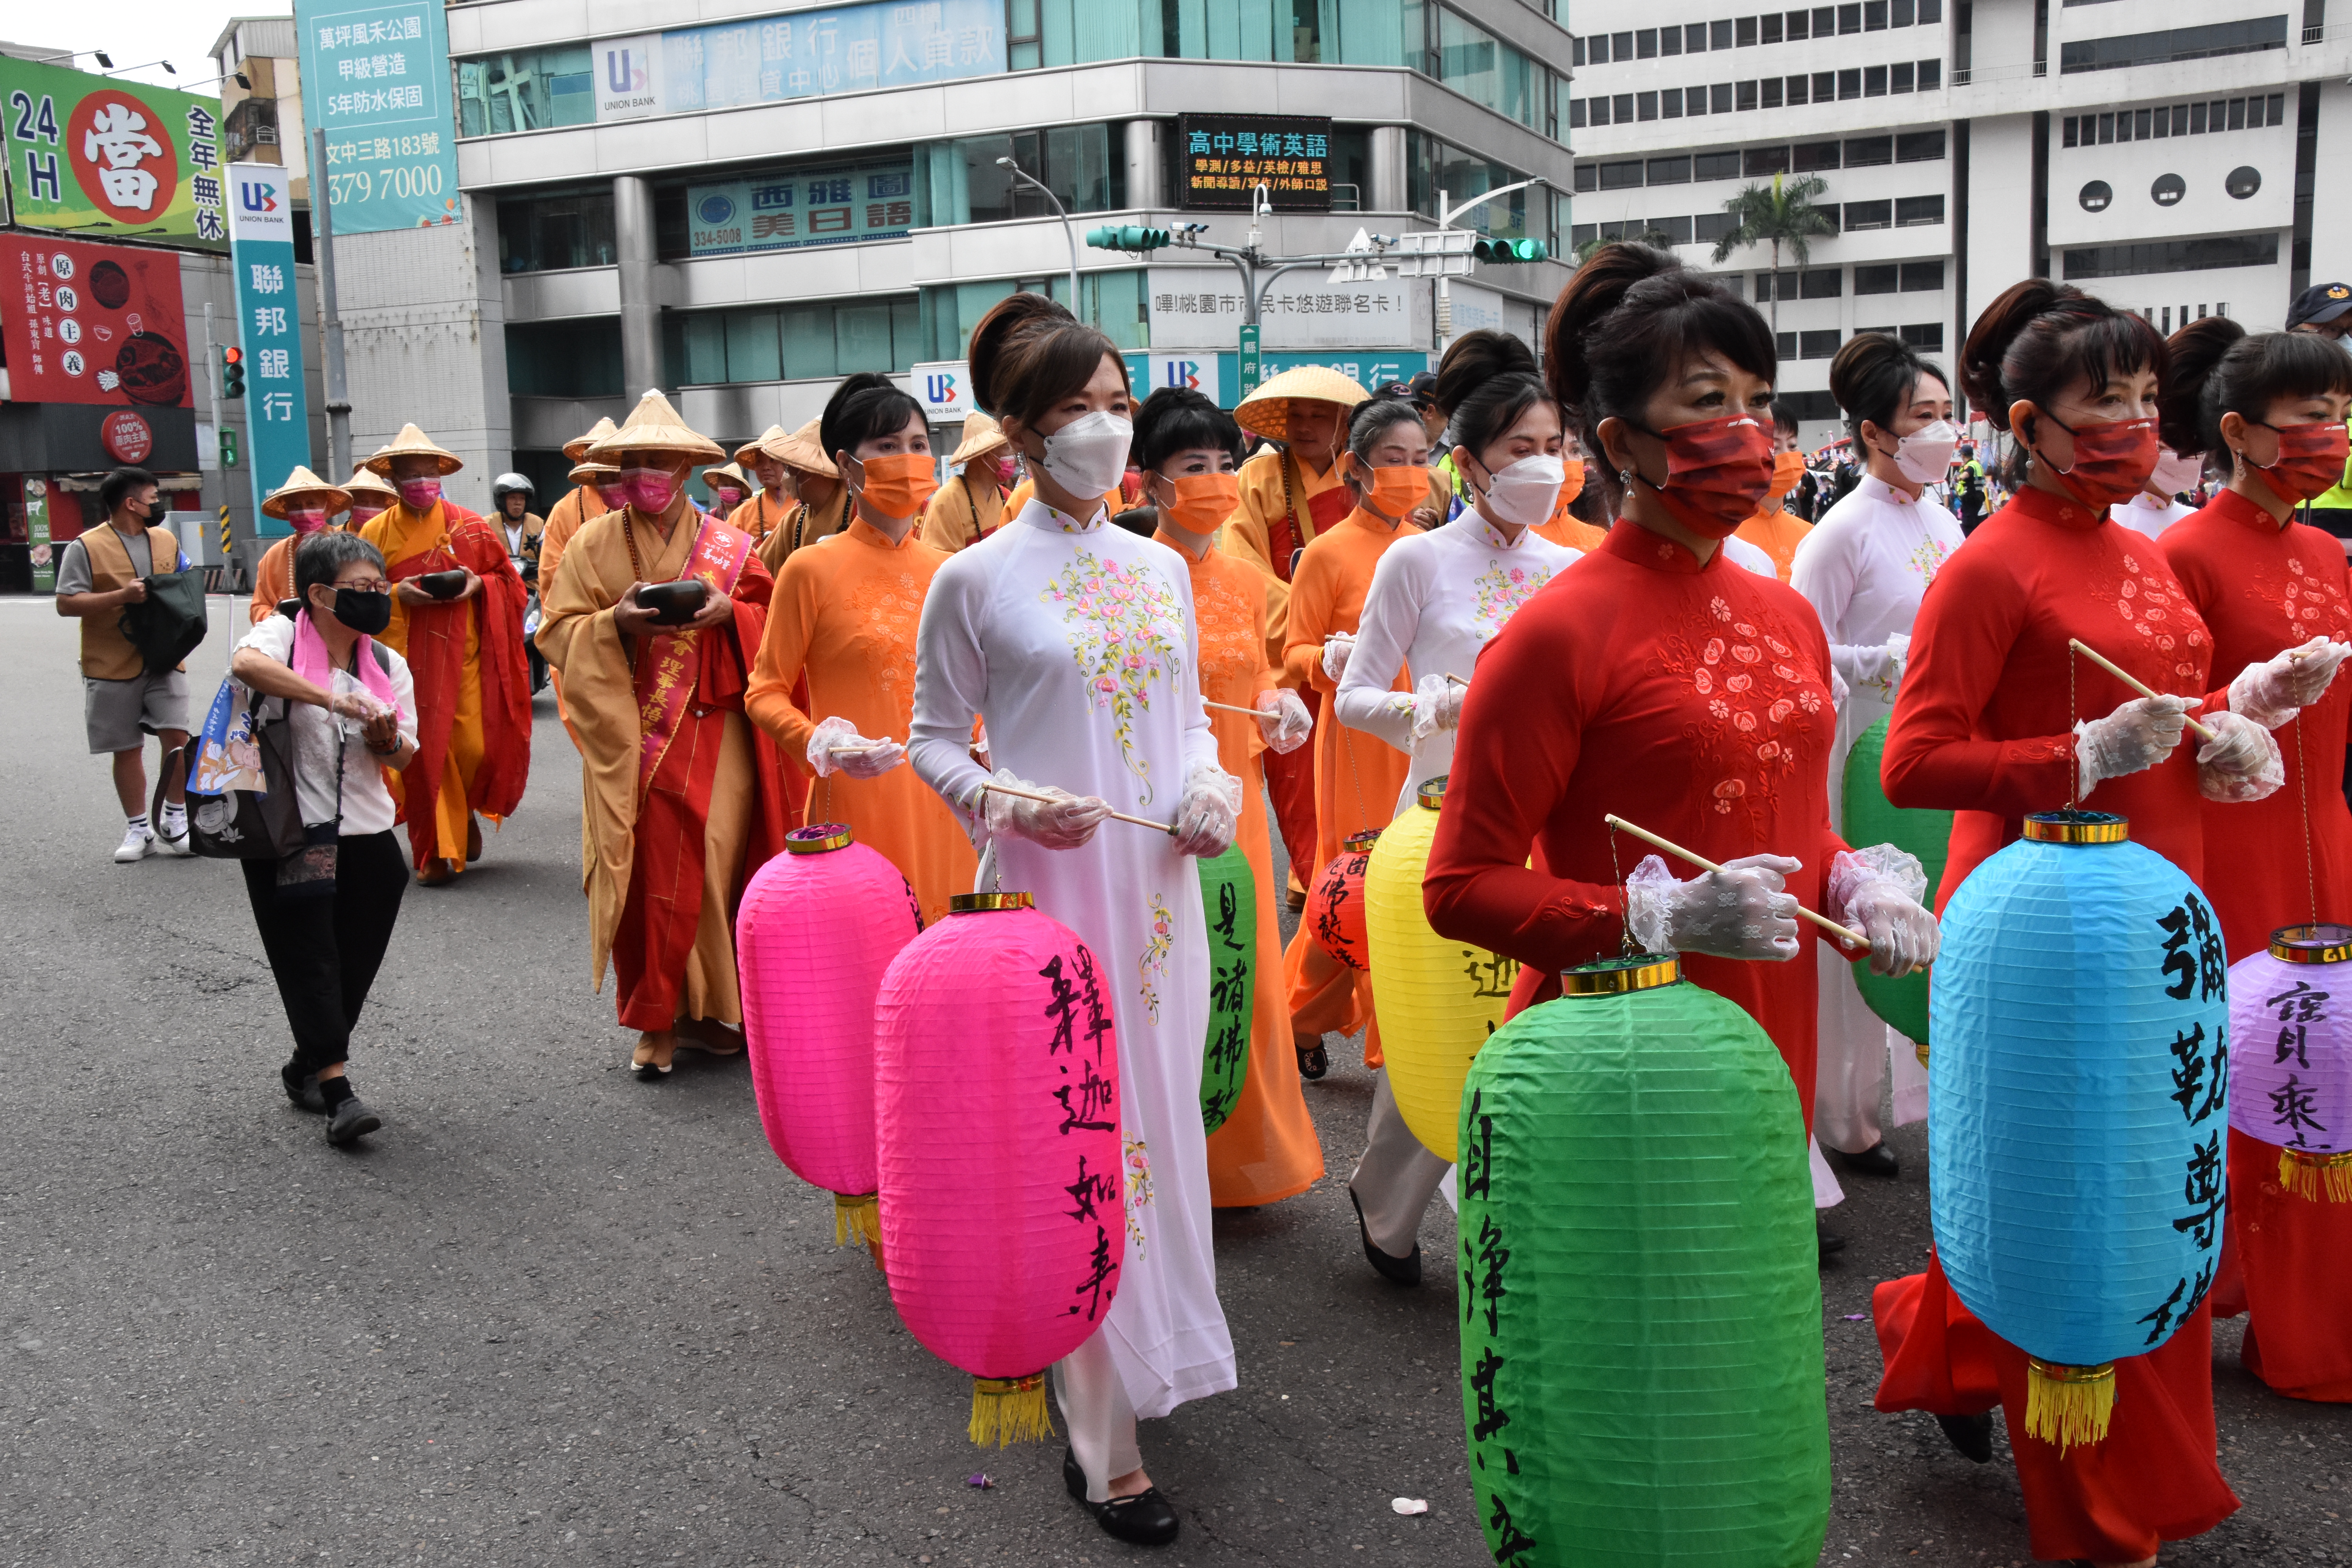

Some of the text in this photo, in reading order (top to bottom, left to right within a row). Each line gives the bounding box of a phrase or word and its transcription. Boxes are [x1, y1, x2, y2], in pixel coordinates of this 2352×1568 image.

[319, 16, 421, 51] 萬坪風禾公園
[674, 18, 838, 71] 聯邦銀行
[847, 24, 995, 80] 個人貸款
[339, 53, 407, 81] 甲級營造
[11, 90, 59, 146] 24
[328, 85, 423, 116] 5年防水保固
[605, 97, 656, 111] UNION BANK
[85, 103, 162, 211] 當
[326, 132, 440, 165] 文中三路183號
[1189, 130, 1327, 157] 高中學術英語
[25, 149, 61, 203] H
[187, 105, 224, 241] 全年無休
[379, 164, 442, 200] 7000
[1195, 158, 1323, 176] 學測/多益/英檢/雅思
[751, 173, 911, 211] 西雅圖
[694, 228, 742, 247] 334-5008
[752, 201, 912, 239] 美日語
[56, 258, 81, 372] 原肉主義
[251, 265, 293, 421] 聯邦銀行
[1244, 341, 1256, 395] 縣府路
[115, 421, 143, 434] 100%
